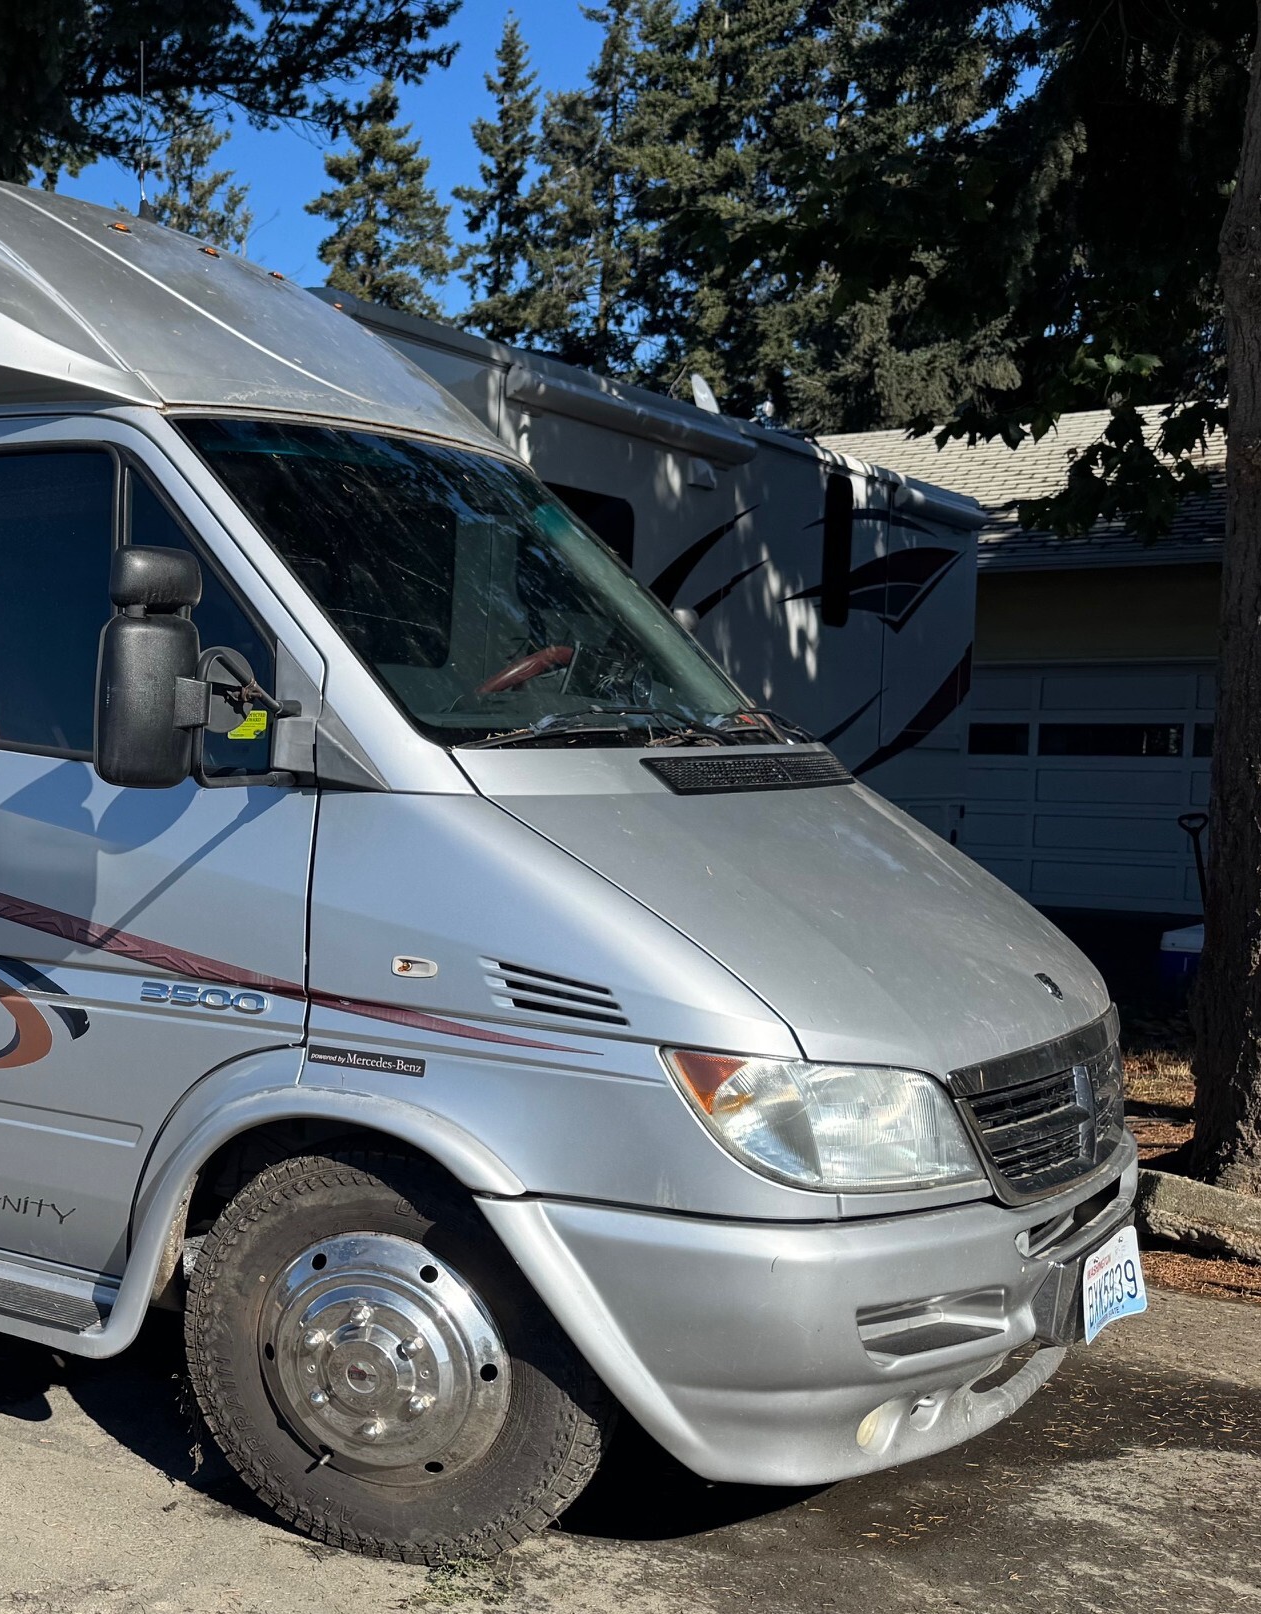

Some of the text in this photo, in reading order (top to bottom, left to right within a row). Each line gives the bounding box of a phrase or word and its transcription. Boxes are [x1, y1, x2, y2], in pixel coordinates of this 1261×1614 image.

[140, 981, 266, 1015] 3500
[310, 1052, 422, 1074] powered by Mercedes-Benz
[213, 1354, 359, 1524] ALL TERRAIN
